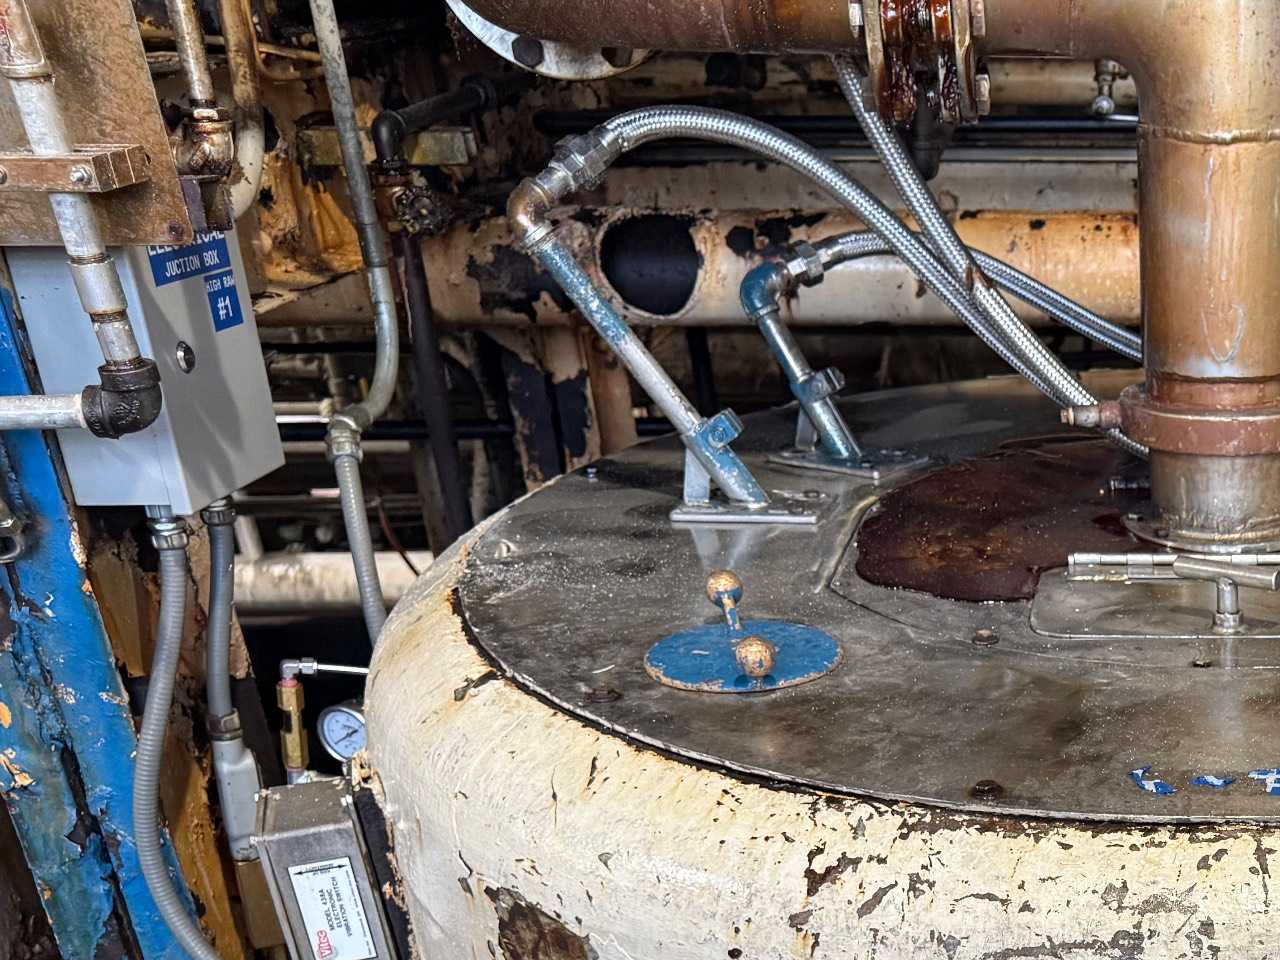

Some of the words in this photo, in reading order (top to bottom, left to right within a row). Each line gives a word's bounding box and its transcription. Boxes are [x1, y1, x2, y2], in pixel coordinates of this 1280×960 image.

[165, 255, 201, 277] JUCTION
[203, 250, 219, 267] BOX
[217, 296, 233, 320] #1
[331, 876, 343, 902] SWITCH
[325, 907, 335, 931] MODEL
[326, 889, 343, 928] ELECTRONIC
[340, 904, 352, 936] VIBRATION
[318, 930, 332, 959] Vitec
